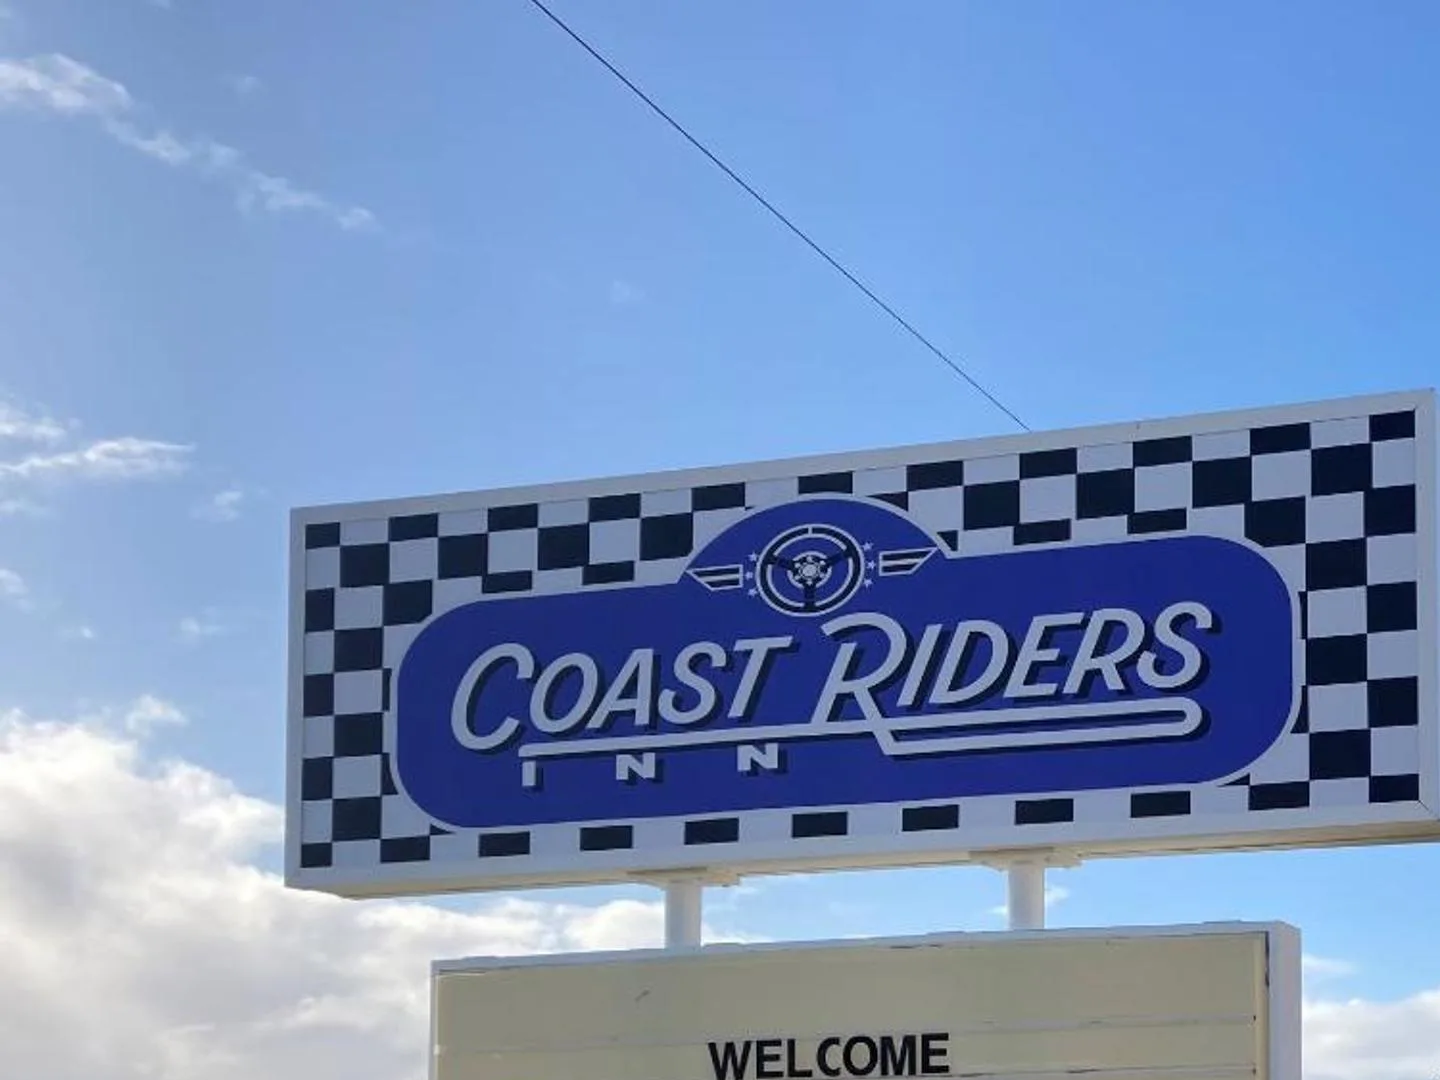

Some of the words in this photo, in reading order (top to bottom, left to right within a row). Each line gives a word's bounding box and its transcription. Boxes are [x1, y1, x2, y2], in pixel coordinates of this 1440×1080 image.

[451, 643, 793, 750] COAST
[811, 602, 1212, 730] RIDERS
[521, 743, 779, 787] INN
